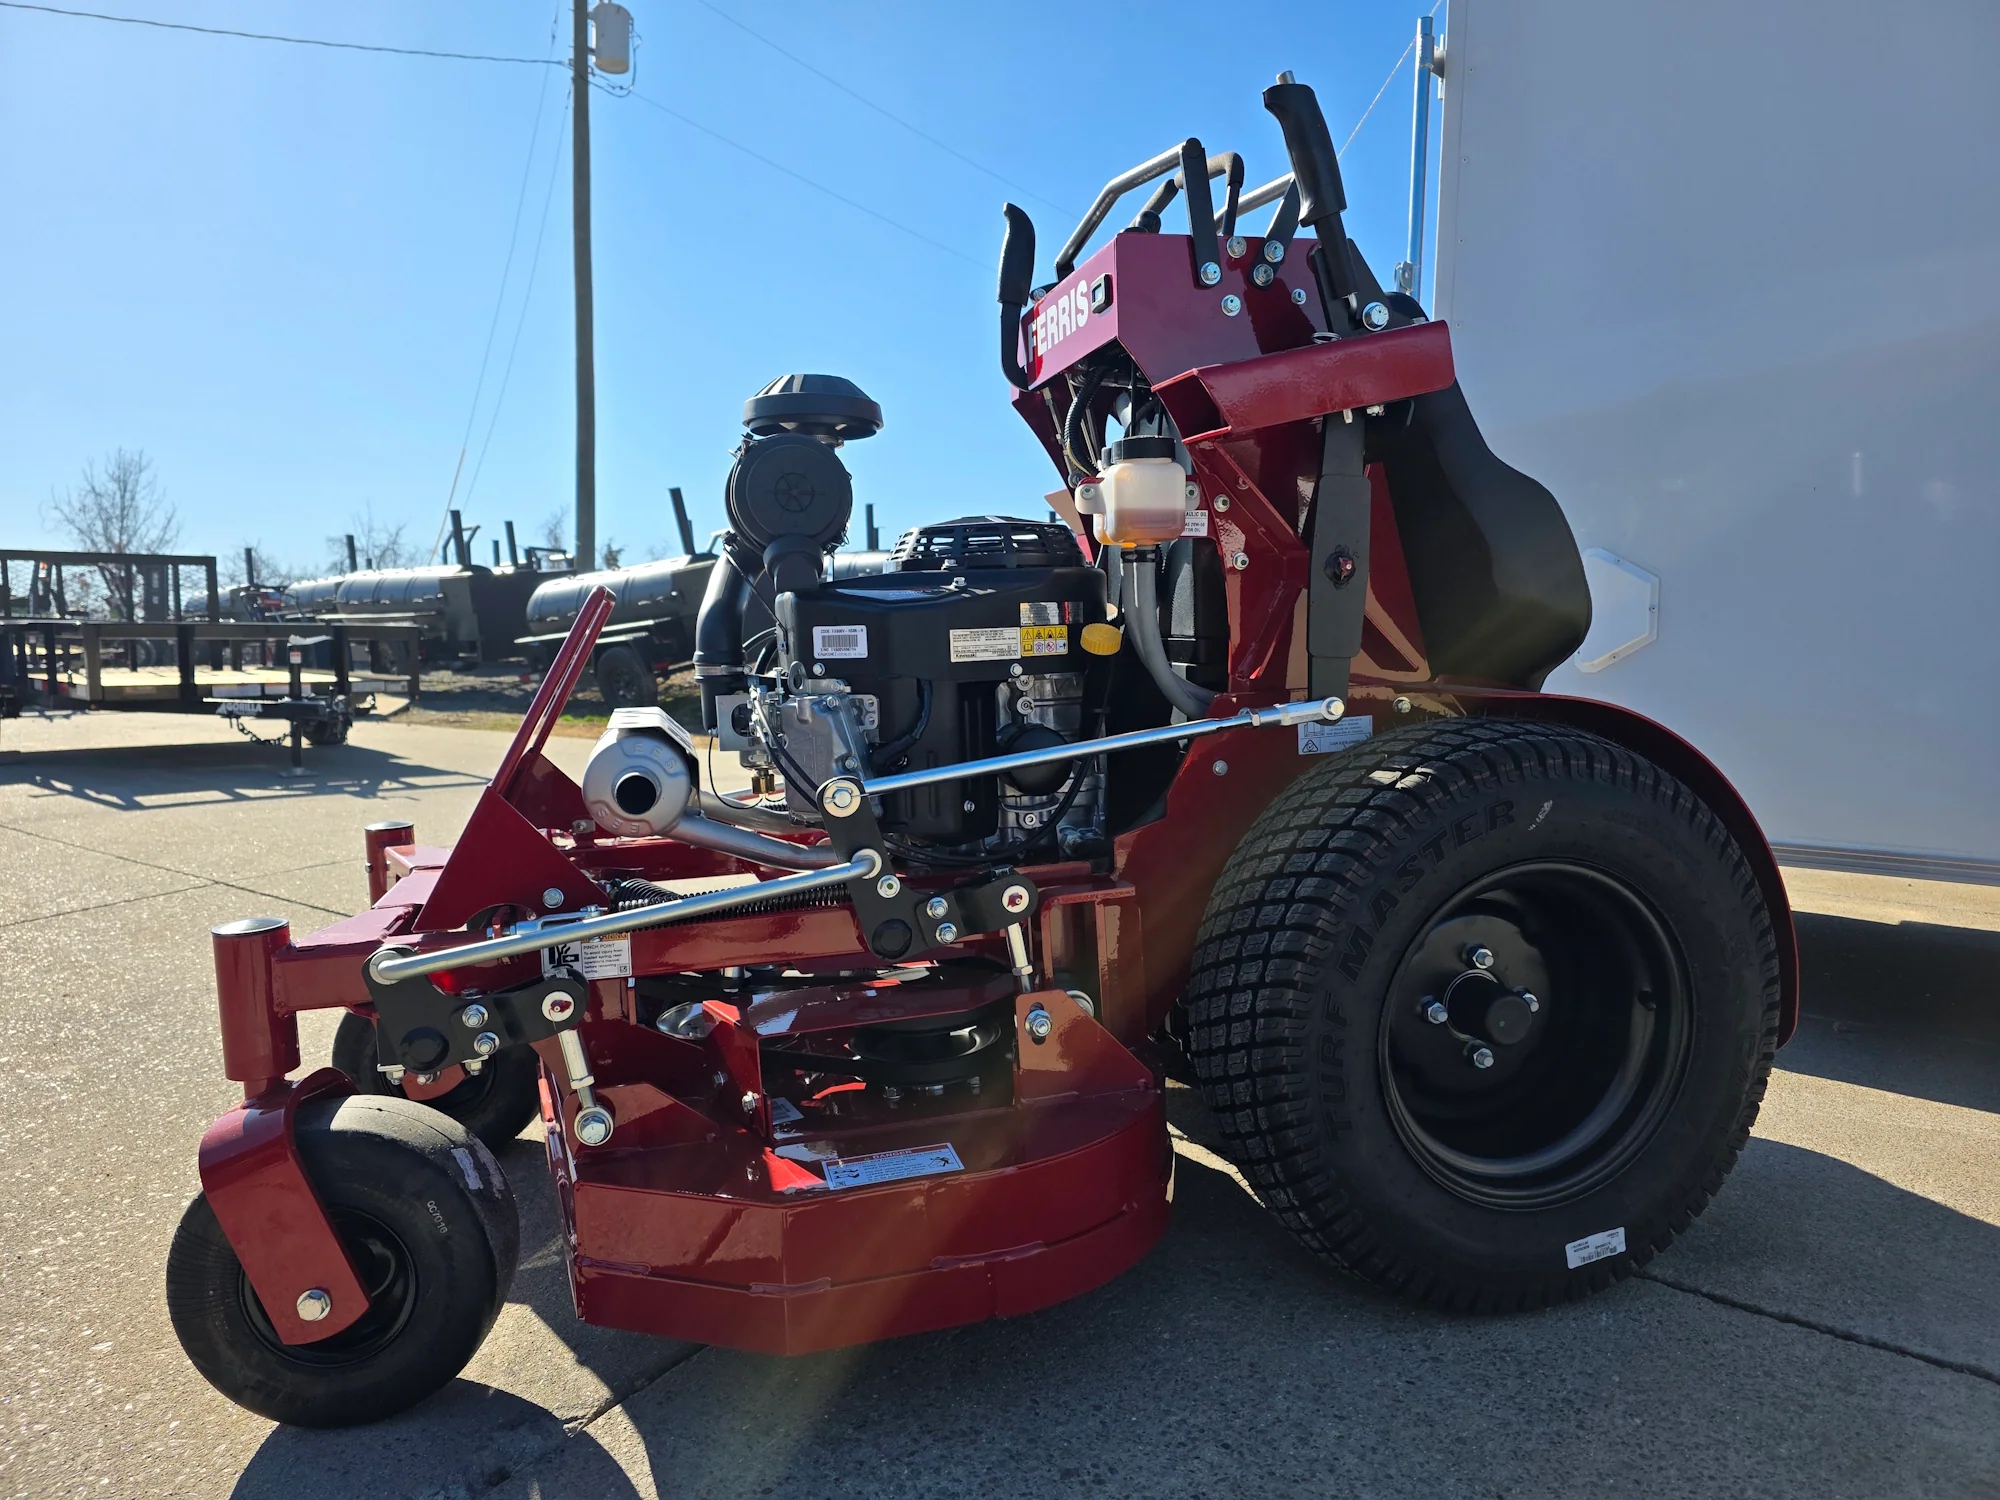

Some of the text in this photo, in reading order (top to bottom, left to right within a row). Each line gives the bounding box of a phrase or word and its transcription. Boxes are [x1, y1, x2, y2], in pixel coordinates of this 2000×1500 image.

[1028, 280, 1089, 363] FERRIS
[226, 702, 263, 713] GORILLA
[1336, 799, 1517, 984] MASTER
[1317, 990, 1354, 1143] TURF
[872, 1149, 913, 1160] DANGER
